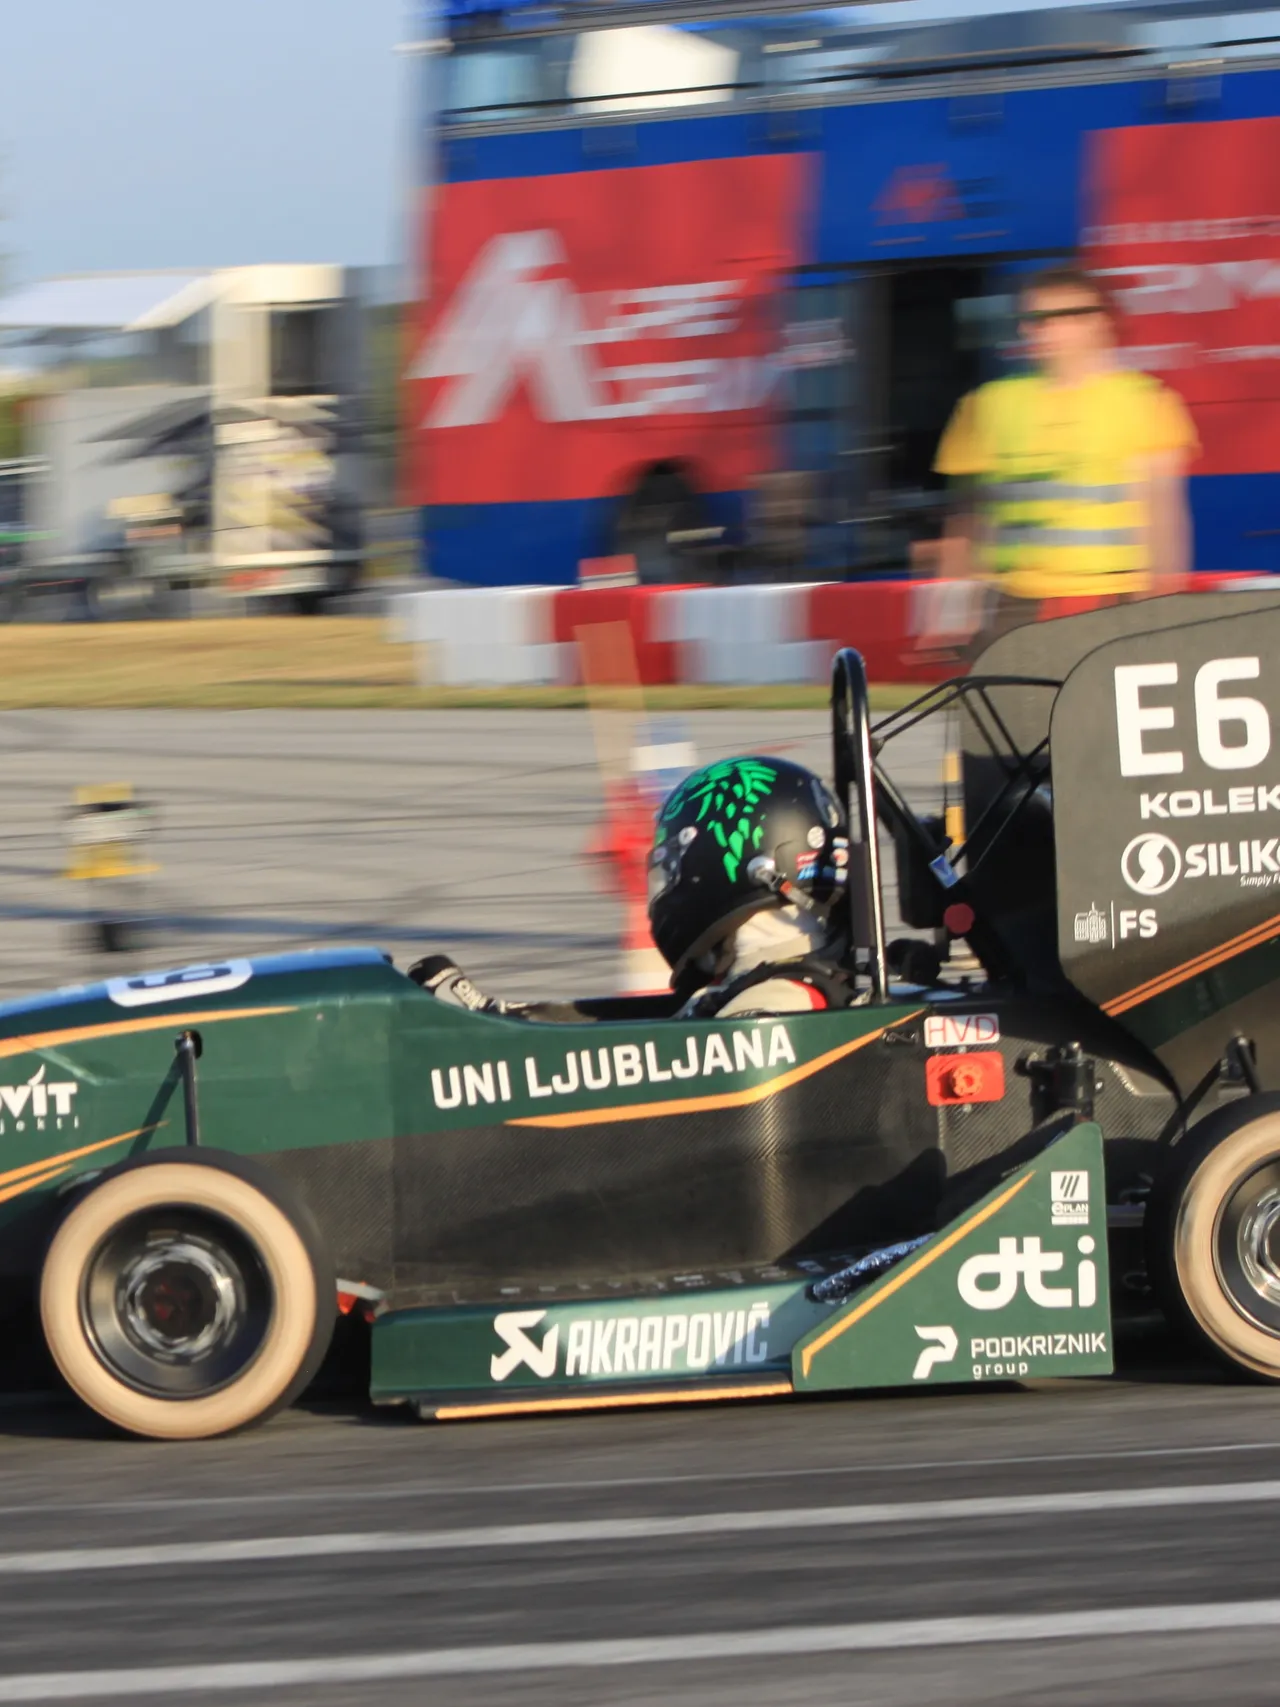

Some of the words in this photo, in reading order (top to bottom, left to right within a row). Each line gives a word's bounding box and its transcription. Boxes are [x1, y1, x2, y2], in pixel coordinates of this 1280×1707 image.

[1114, 656, 1271, 777] E6
[1139, 784, 1280, 819] KOLEK
[1183, 838, 1280, 878] SILIK
[1240, 873, 1272, 888] Simply
[1119, 908, 1158, 939] FS
[927, 1014, 998, 1044] HVD
[431, 1060, 511, 1109] UNI
[524, 1024, 797, 1098] LJUBLJANA
[957, 1234, 1096, 1310] dti
[970, 1332, 1107, 1359] PODKRIZNIK
[972, 1361, 1029, 1380] group
